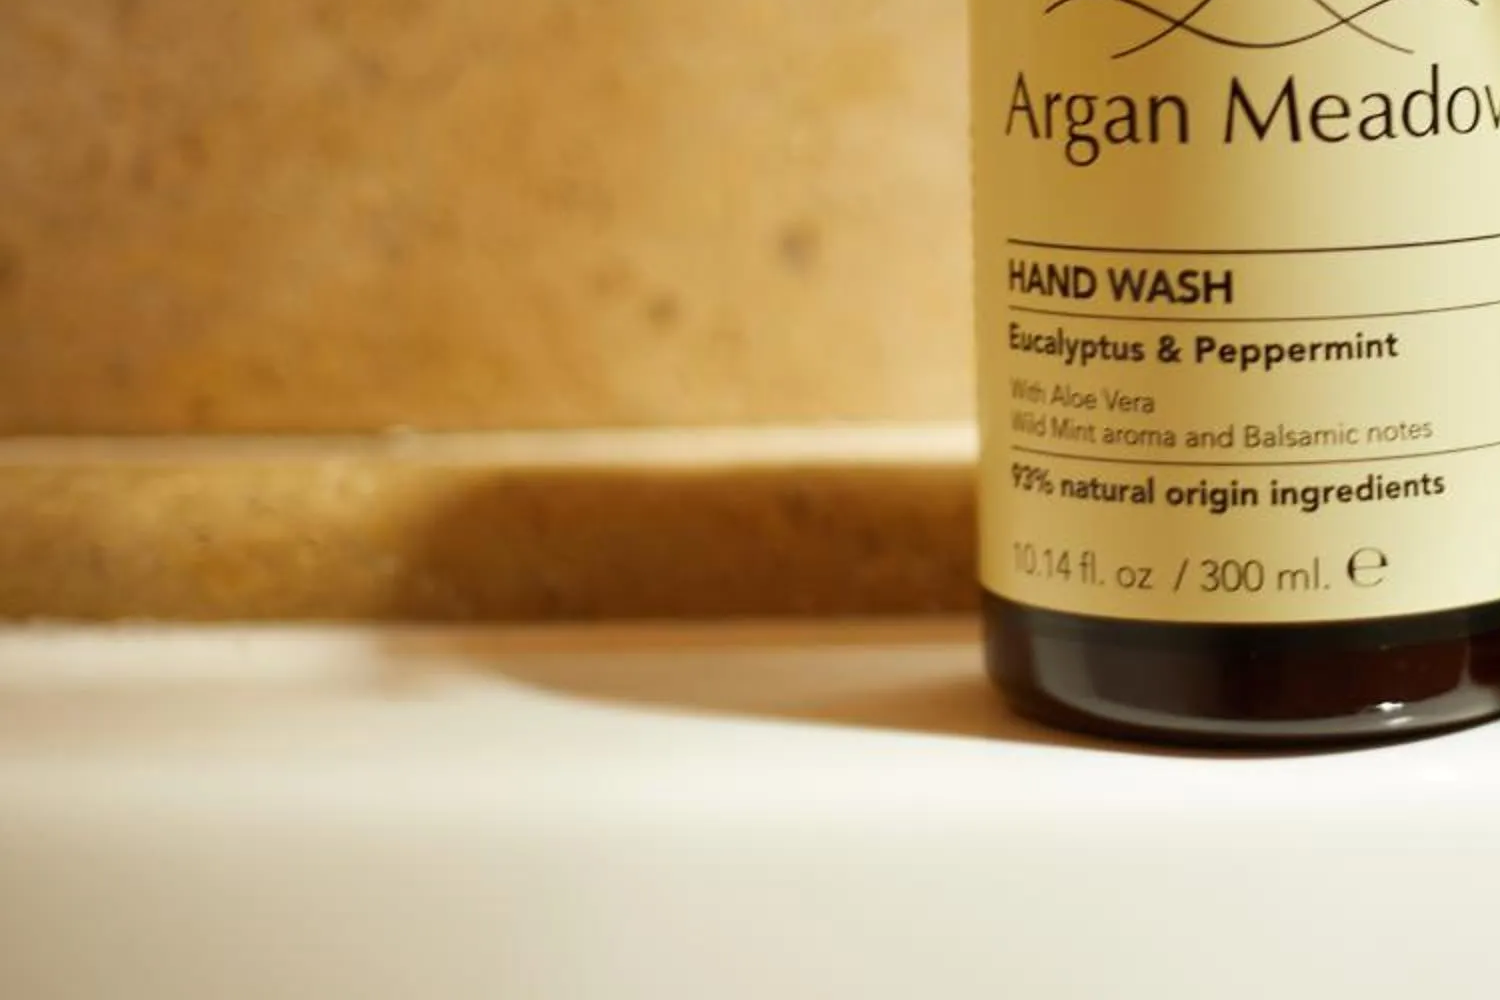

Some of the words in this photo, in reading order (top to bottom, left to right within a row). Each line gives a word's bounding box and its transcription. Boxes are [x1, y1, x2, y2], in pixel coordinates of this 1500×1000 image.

[1005, 72, 1189, 167] Argan
[1009, 259, 1097, 299] HAND
[1107, 267, 1233, 305] WASH
[1009, 320, 1147, 367] Eucalyptus
[1156, 334, 1182, 364] &
[1195, 332, 1398, 372] Peppermint
[1050, 384, 1098, 411] Aloe
[1102, 389, 1155, 414] Vera
[1050, 416, 1096, 444] Mint
[1102, 427, 1177, 448] aroma
[1185, 424, 1234, 449] and
[1243, 424, 1359, 449] Balsamic
[1367, 421, 1433, 443] notes
[1060, 476, 1155, 504] natural
[1165, 479, 1259, 515] origin
[1270, 474, 1445, 513] ingredients
[1116, 566, 1153, 590] oz
[1173, 558, 1189, 593] /
[1200, 559, 1265, 592] 300
[1277, 557, 1330, 591] ml.
